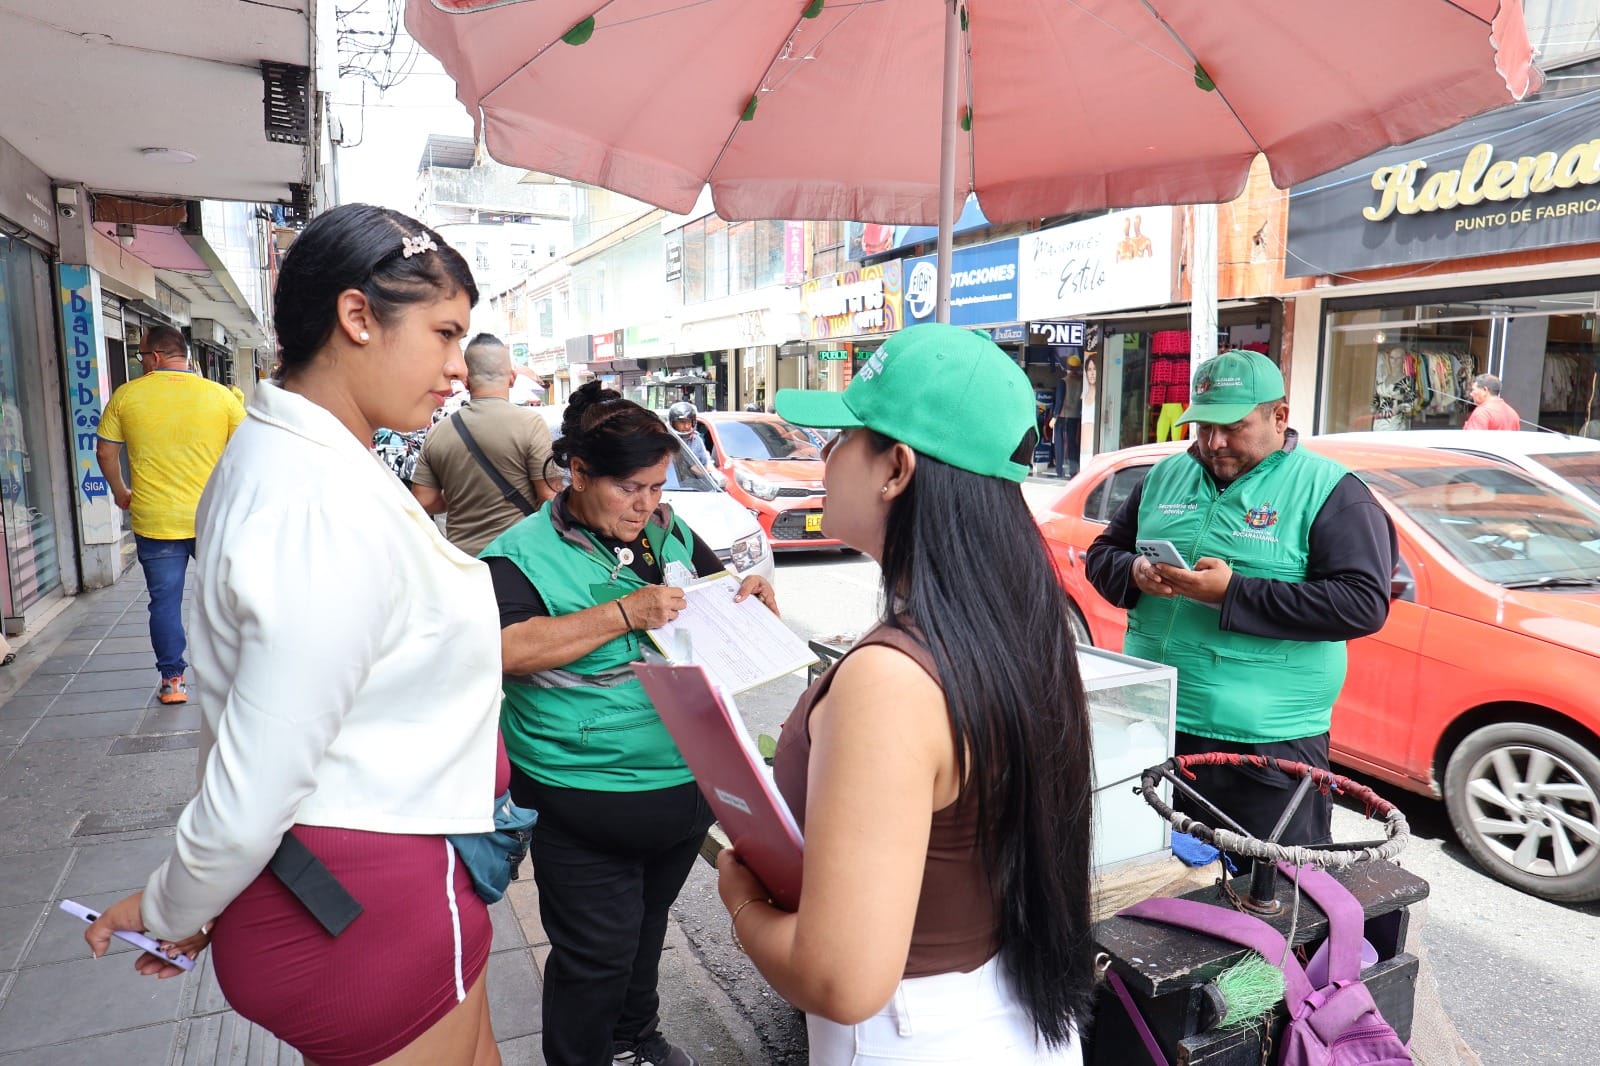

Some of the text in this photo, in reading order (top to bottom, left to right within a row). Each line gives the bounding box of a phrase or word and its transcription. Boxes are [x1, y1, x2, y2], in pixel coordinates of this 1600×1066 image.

[1362, 138, 1600, 221] Kalena
[1455, 213, 1507, 232] PUNTO
[1510, 209, 1532, 224] DE
[1057, 256, 1105, 300] Estilo
[84, 480, 105, 492] SIGA
